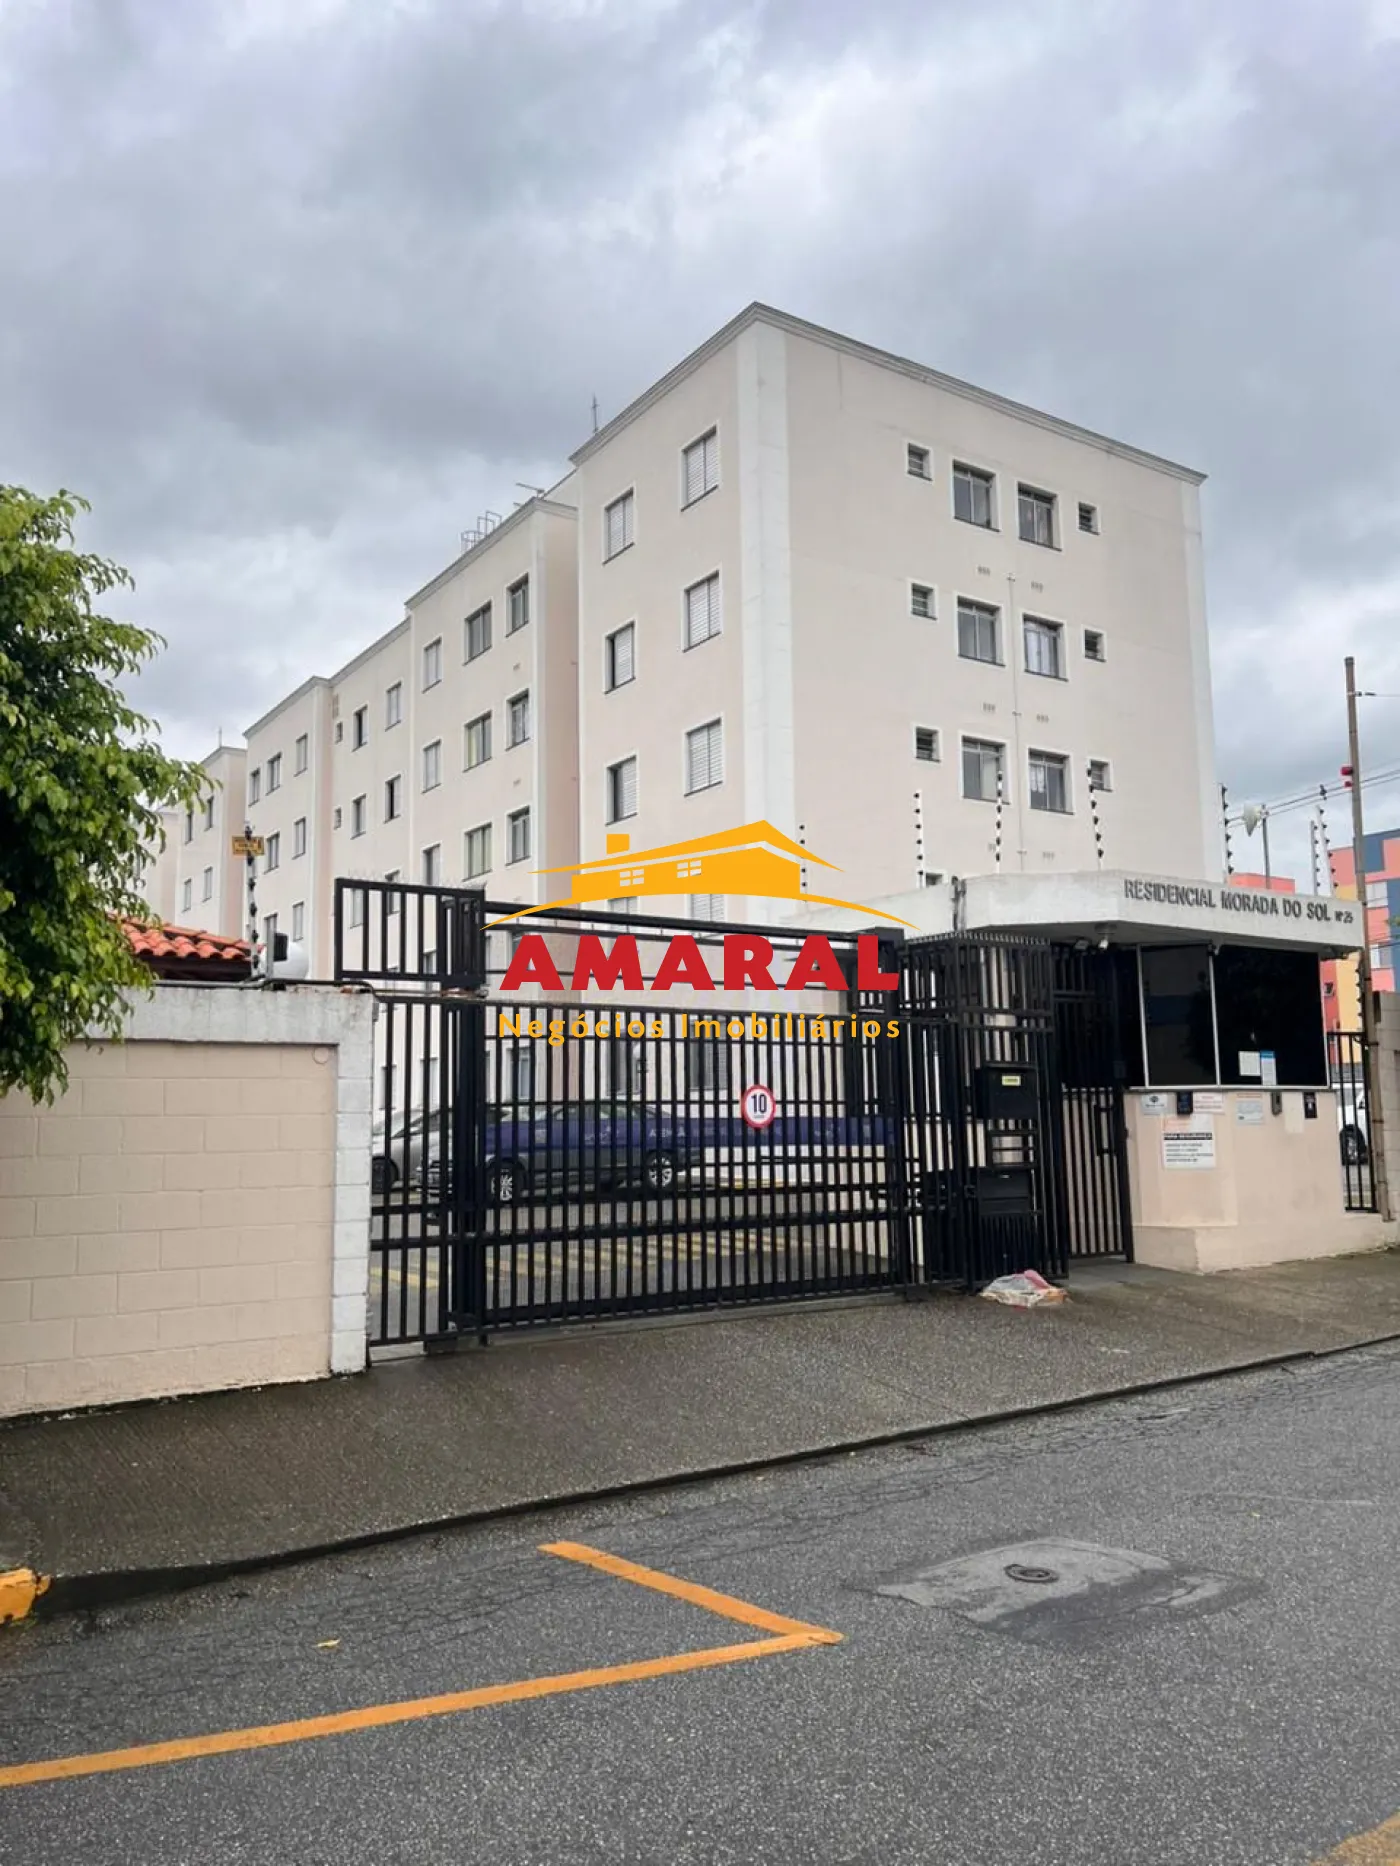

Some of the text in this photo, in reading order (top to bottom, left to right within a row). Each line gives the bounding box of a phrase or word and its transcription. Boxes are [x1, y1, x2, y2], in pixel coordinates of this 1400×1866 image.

[1124, 879, 1217, 908] RESIDENCIAL
[1221, 889, 1279, 915] MORADA
[1282, 898, 1302, 918] DO
[1306, 902, 1331, 921] SOL
[751, 1093, 767, 1114] 10
